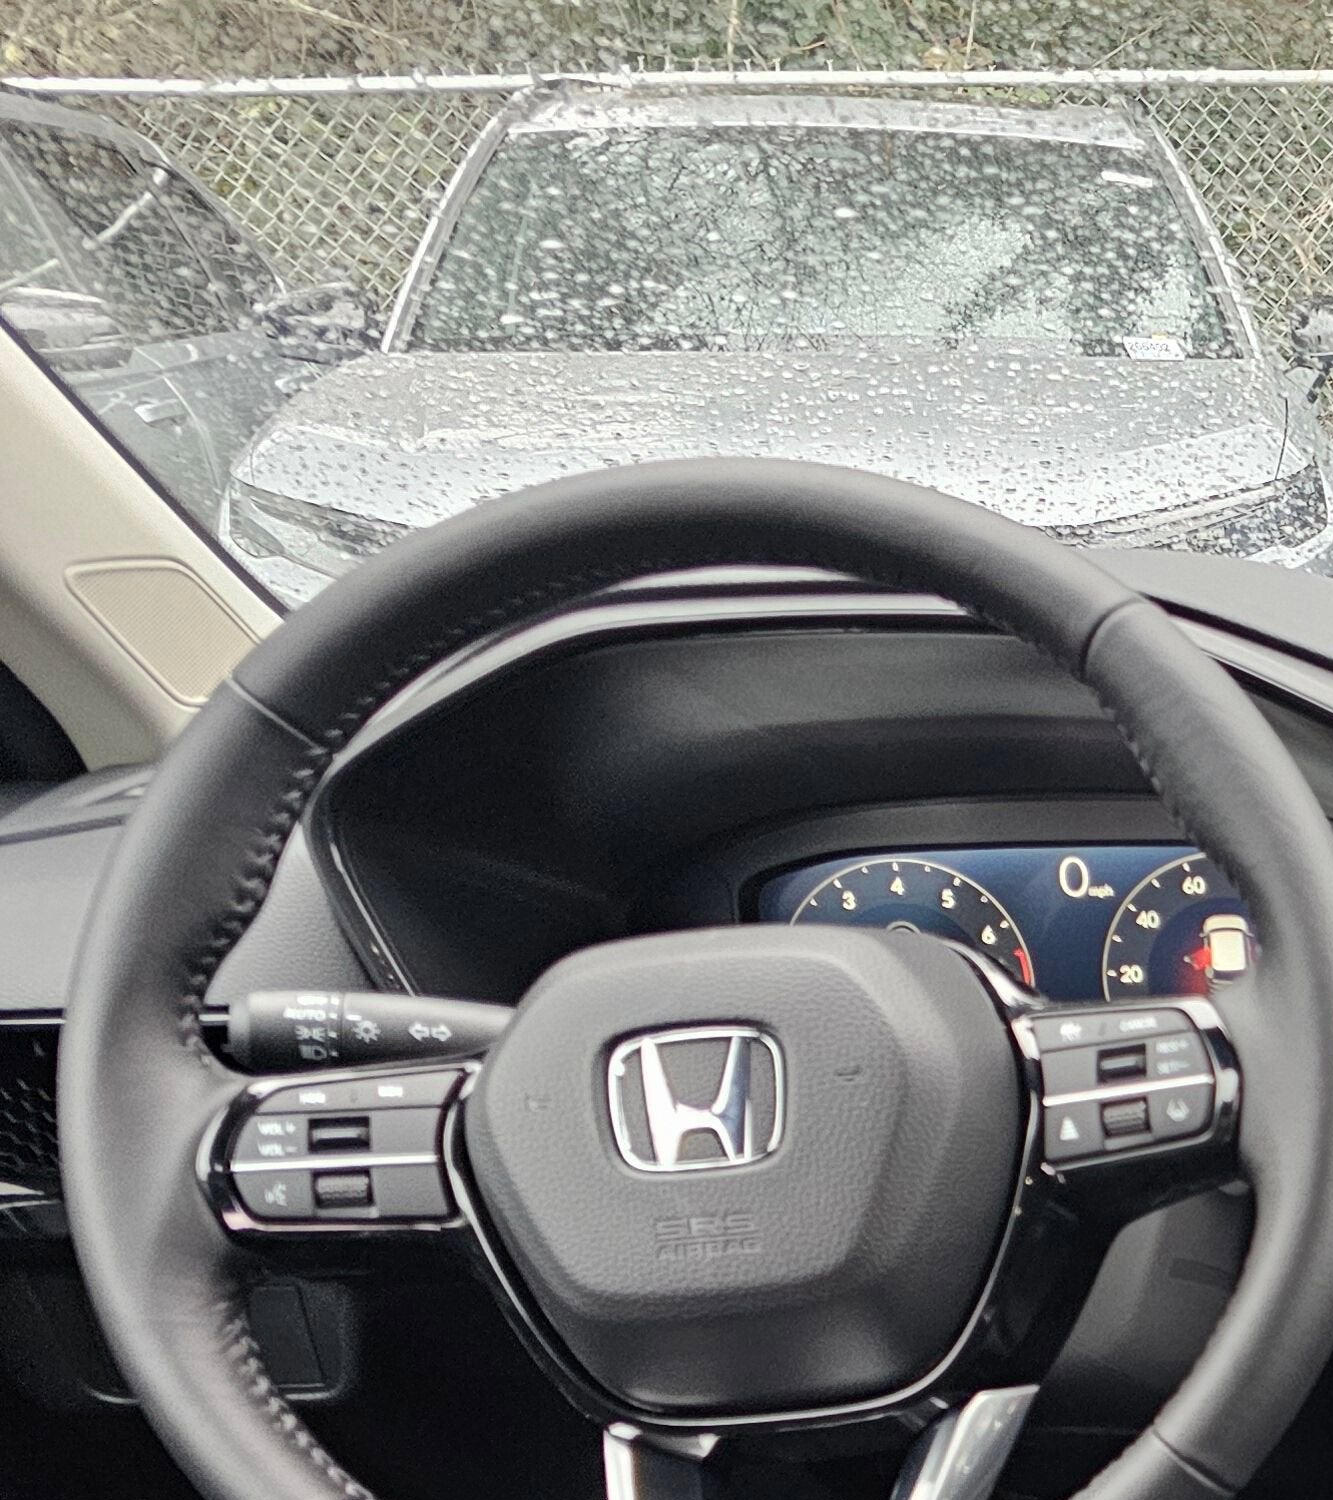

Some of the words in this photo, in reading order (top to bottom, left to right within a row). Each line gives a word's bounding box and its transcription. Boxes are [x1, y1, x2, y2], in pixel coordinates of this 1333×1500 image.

[890, 876, 905, 895] 4
[1088, 883, 1115, 898] mph
[1182, 876, 1206, 895] 60
[841, 890, 857, 910] 3
[941, 888, 956, 909] 5
[1135, 910, 1160, 929] 40
[981, 925, 997, 945] 6
[1119, 964, 1144, 983] 20
[656, 1214, 756, 1237] SRS
[656, 1240, 761, 1260] AIRBAG
